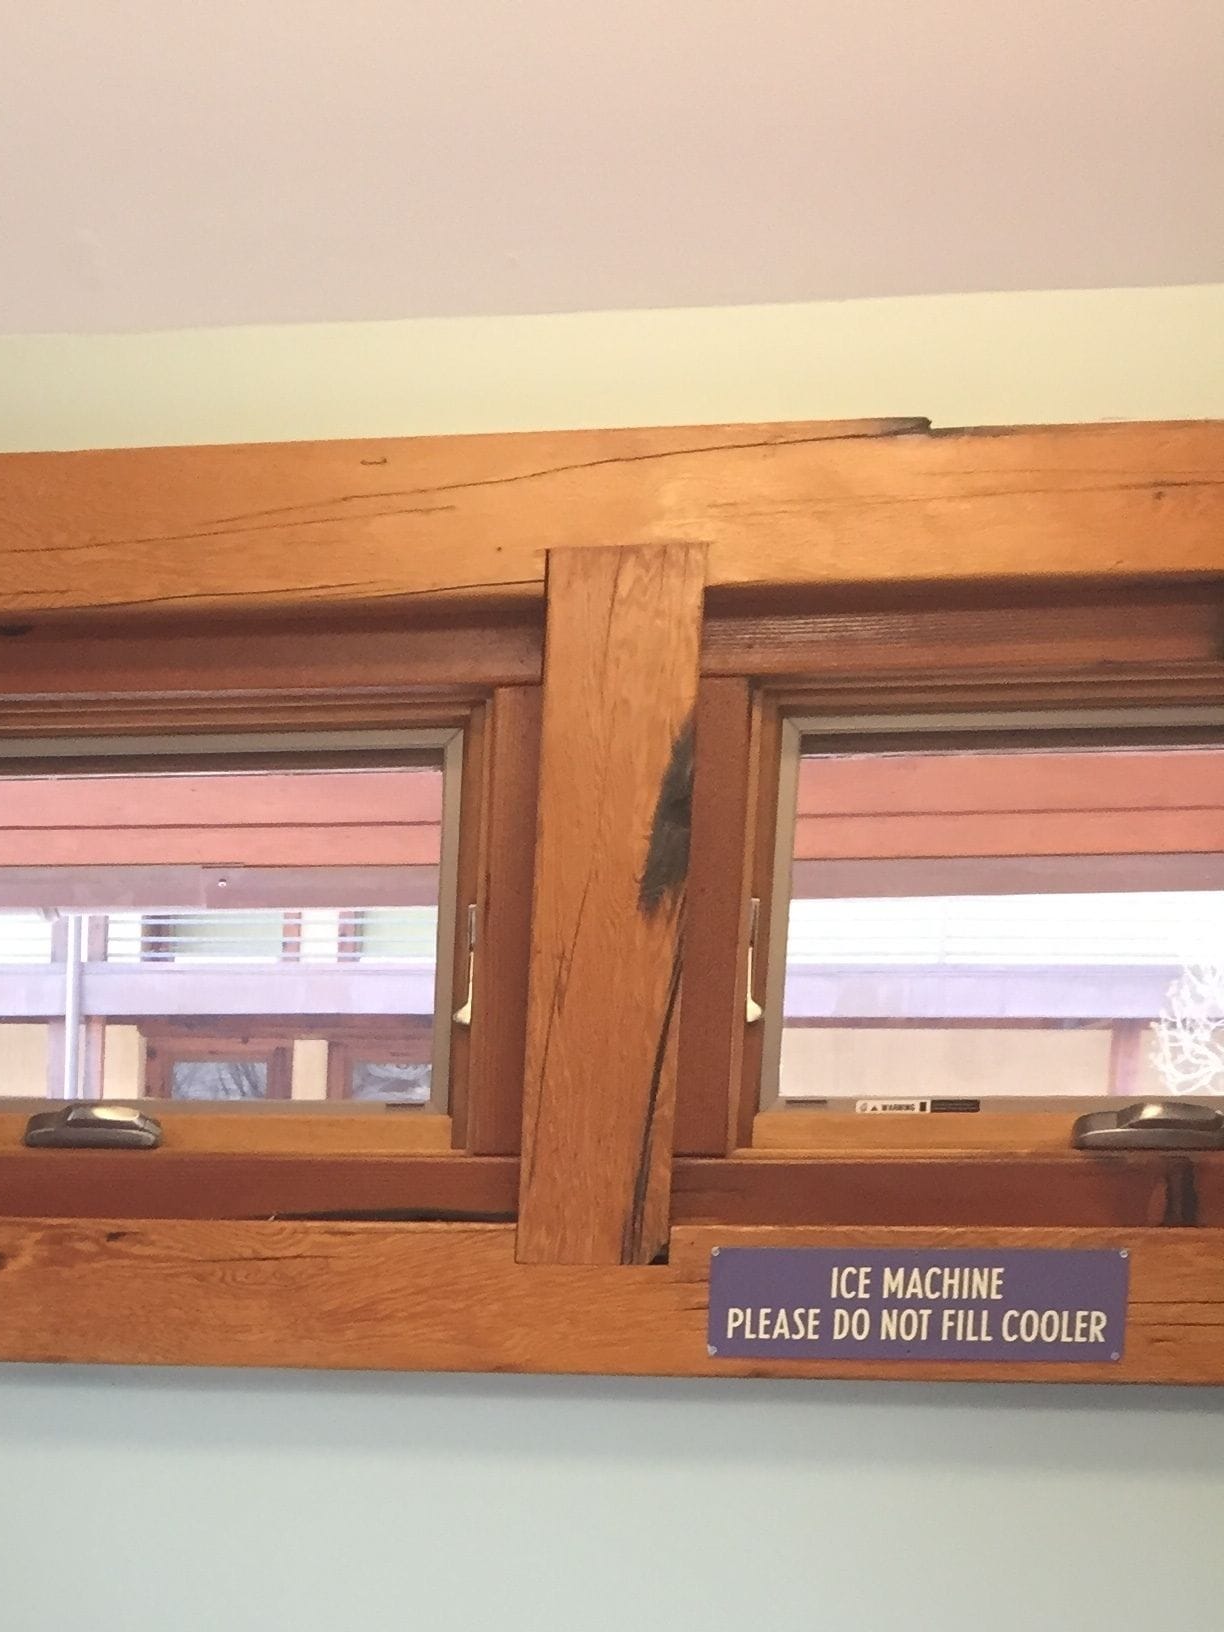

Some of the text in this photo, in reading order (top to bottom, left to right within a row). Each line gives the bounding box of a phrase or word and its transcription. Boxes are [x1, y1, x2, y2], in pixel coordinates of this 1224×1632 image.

[830, 1266, 1005, 1300] ICE MACHINE
[726, 1308, 1107, 1343] PLEASE DO NOT FILL COOLER
